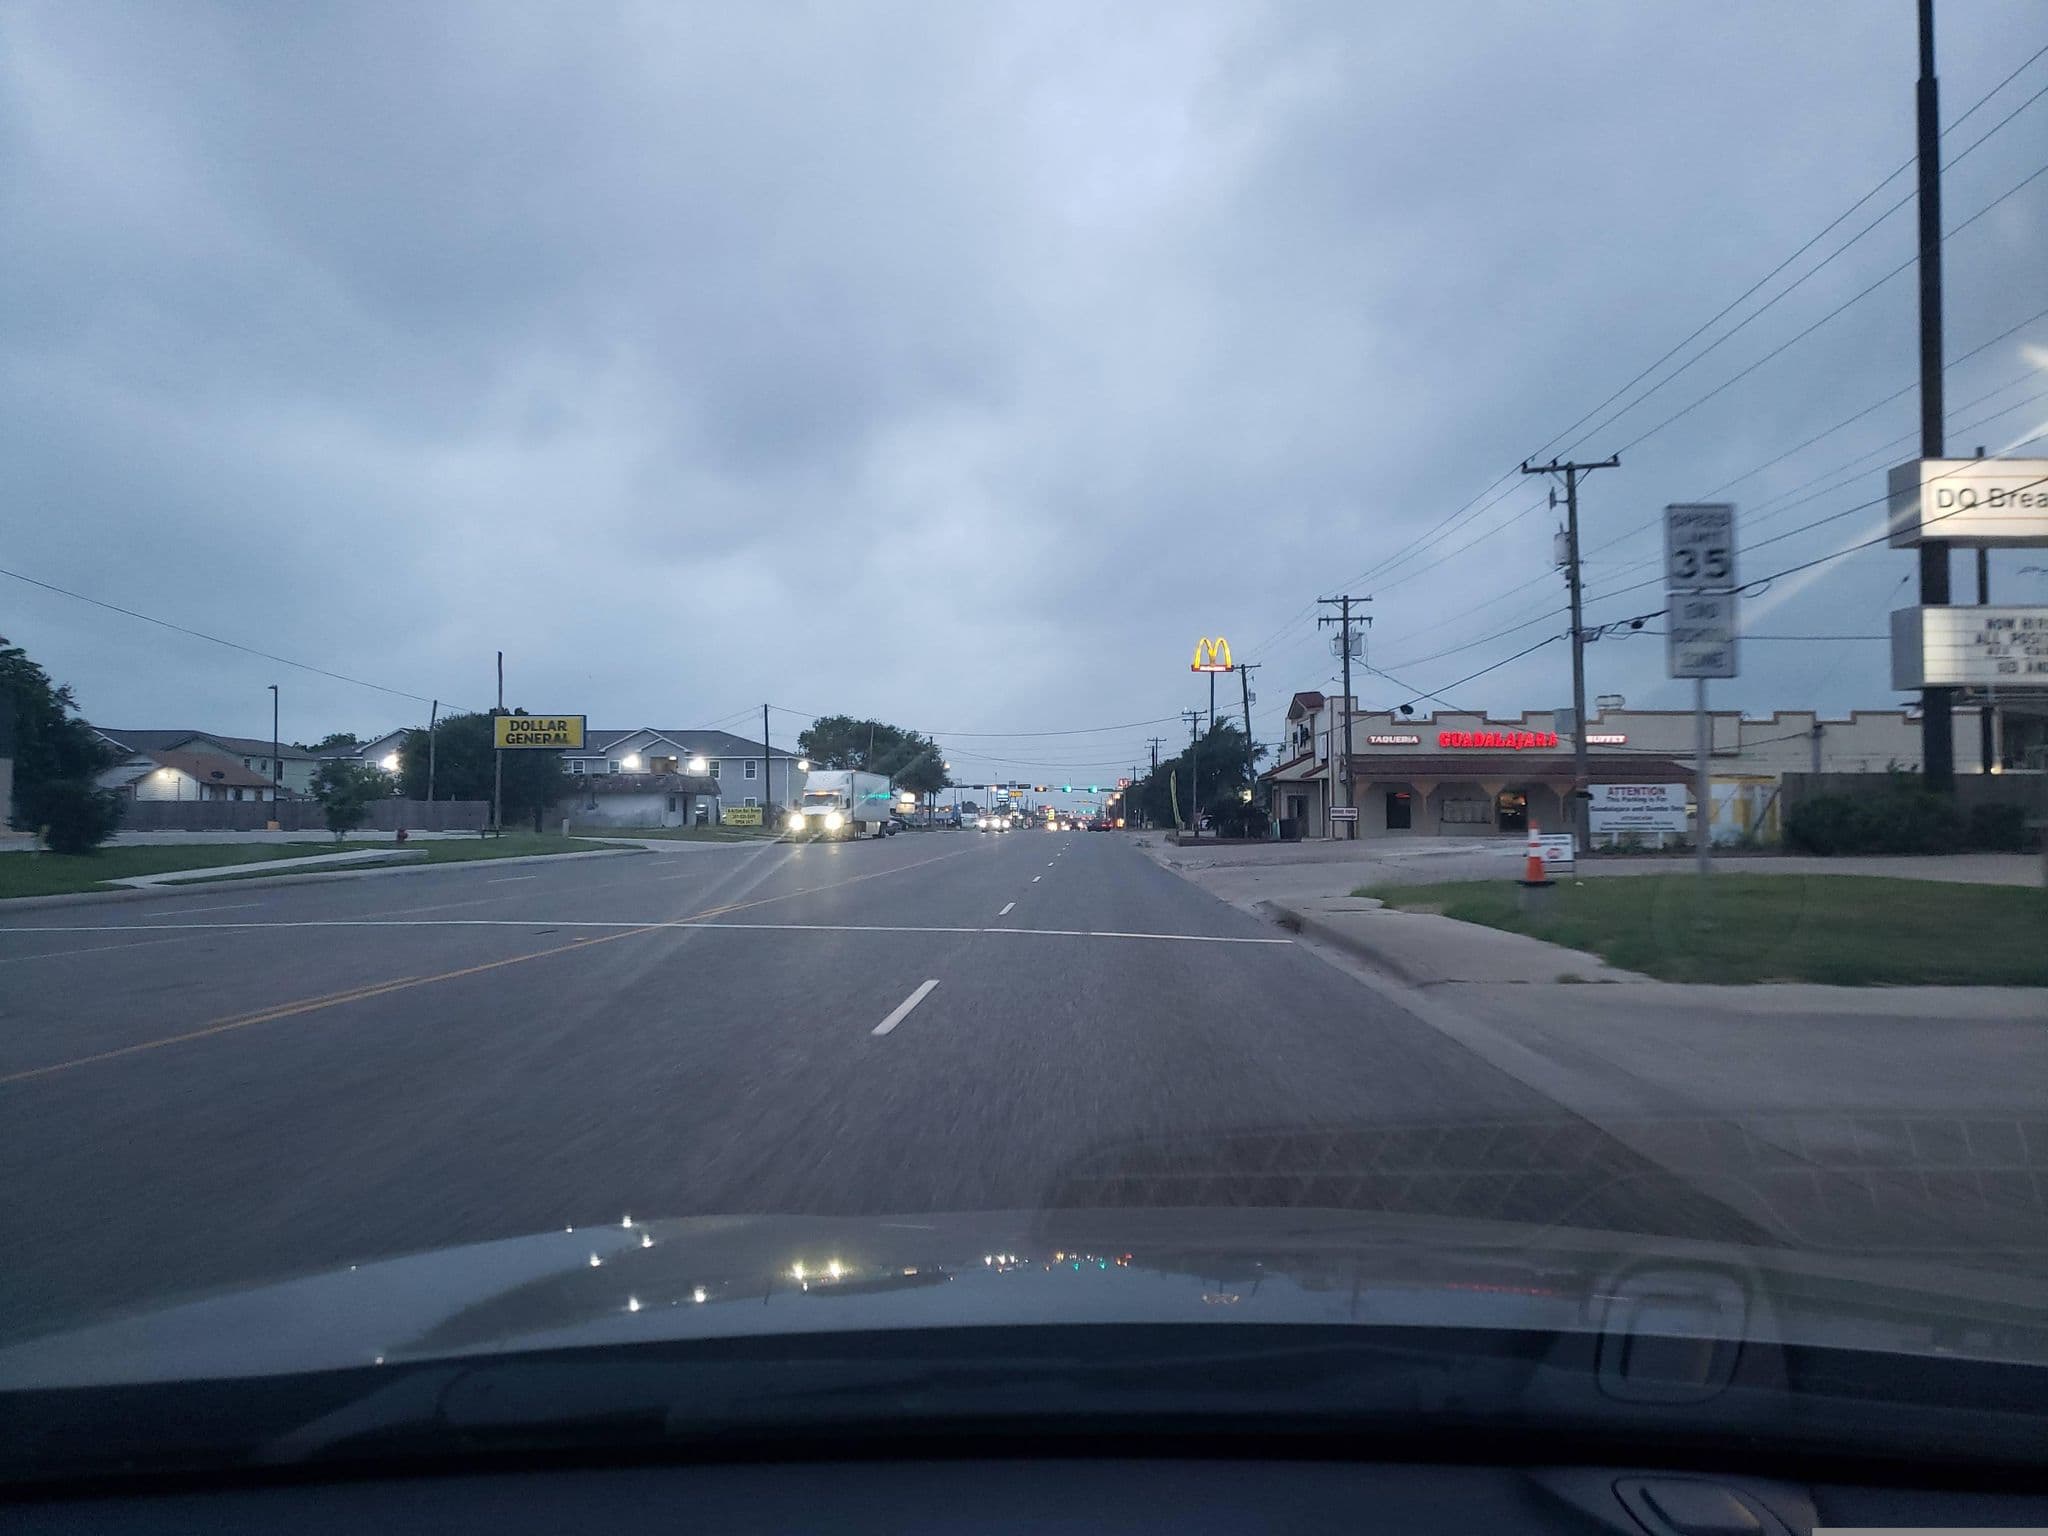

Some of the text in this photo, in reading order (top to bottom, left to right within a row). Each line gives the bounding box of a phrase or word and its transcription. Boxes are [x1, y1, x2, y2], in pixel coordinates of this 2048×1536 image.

[1938, 488, 1977, 508] DQ
[1672, 548, 1728, 579] 35
[510, 720, 568, 732] DOLLAR
[505, 733, 570, 745] GENERAL
[1369, 735, 1419, 744] TAQUERIA
[1438, 731, 1559, 750] GUADALAJARA
[1607, 786, 1667, 796] ATTENTION
